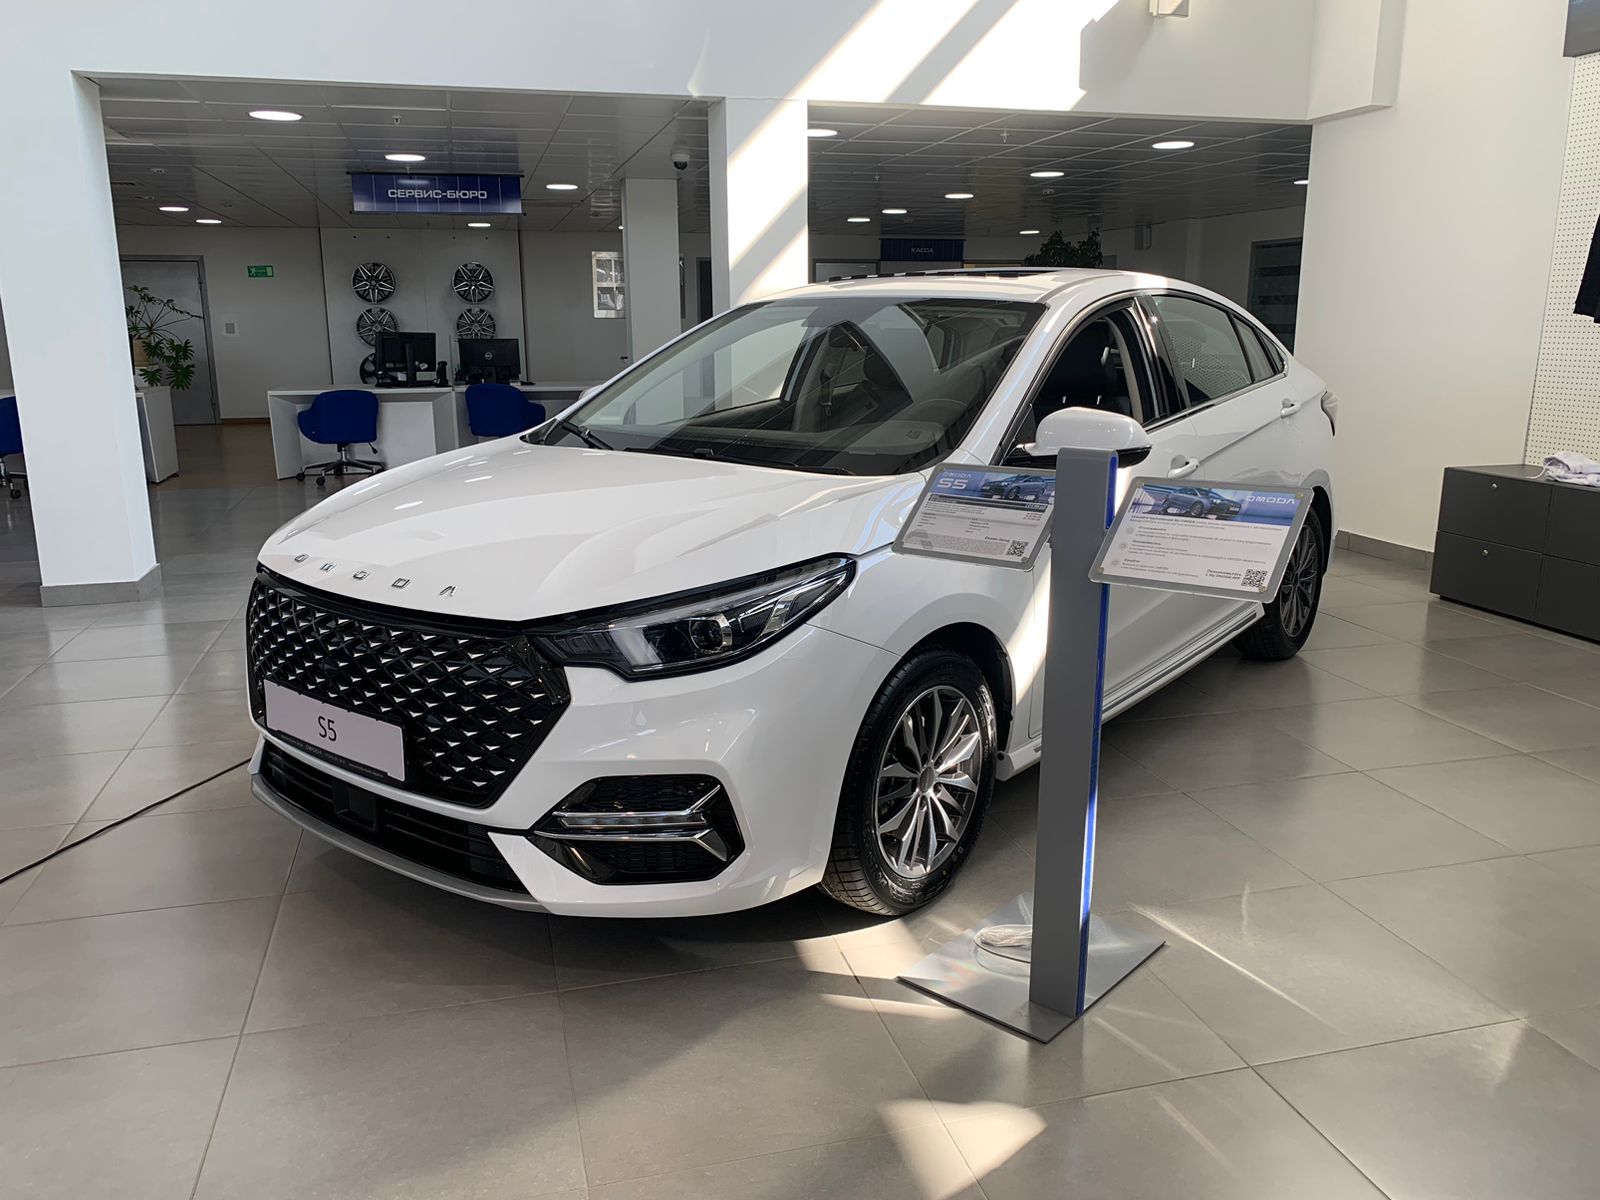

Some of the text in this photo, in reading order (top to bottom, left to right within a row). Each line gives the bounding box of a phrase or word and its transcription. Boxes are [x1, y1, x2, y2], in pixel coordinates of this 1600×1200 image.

[387, 188, 488, 200] СЕРВИС-БЮРО
[937, 477, 969, 490] S5
[1246, 495, 1296, 505] OMODA
[293, 553, 457, 597] OMODA
[317, 715, 337, 742] S5
